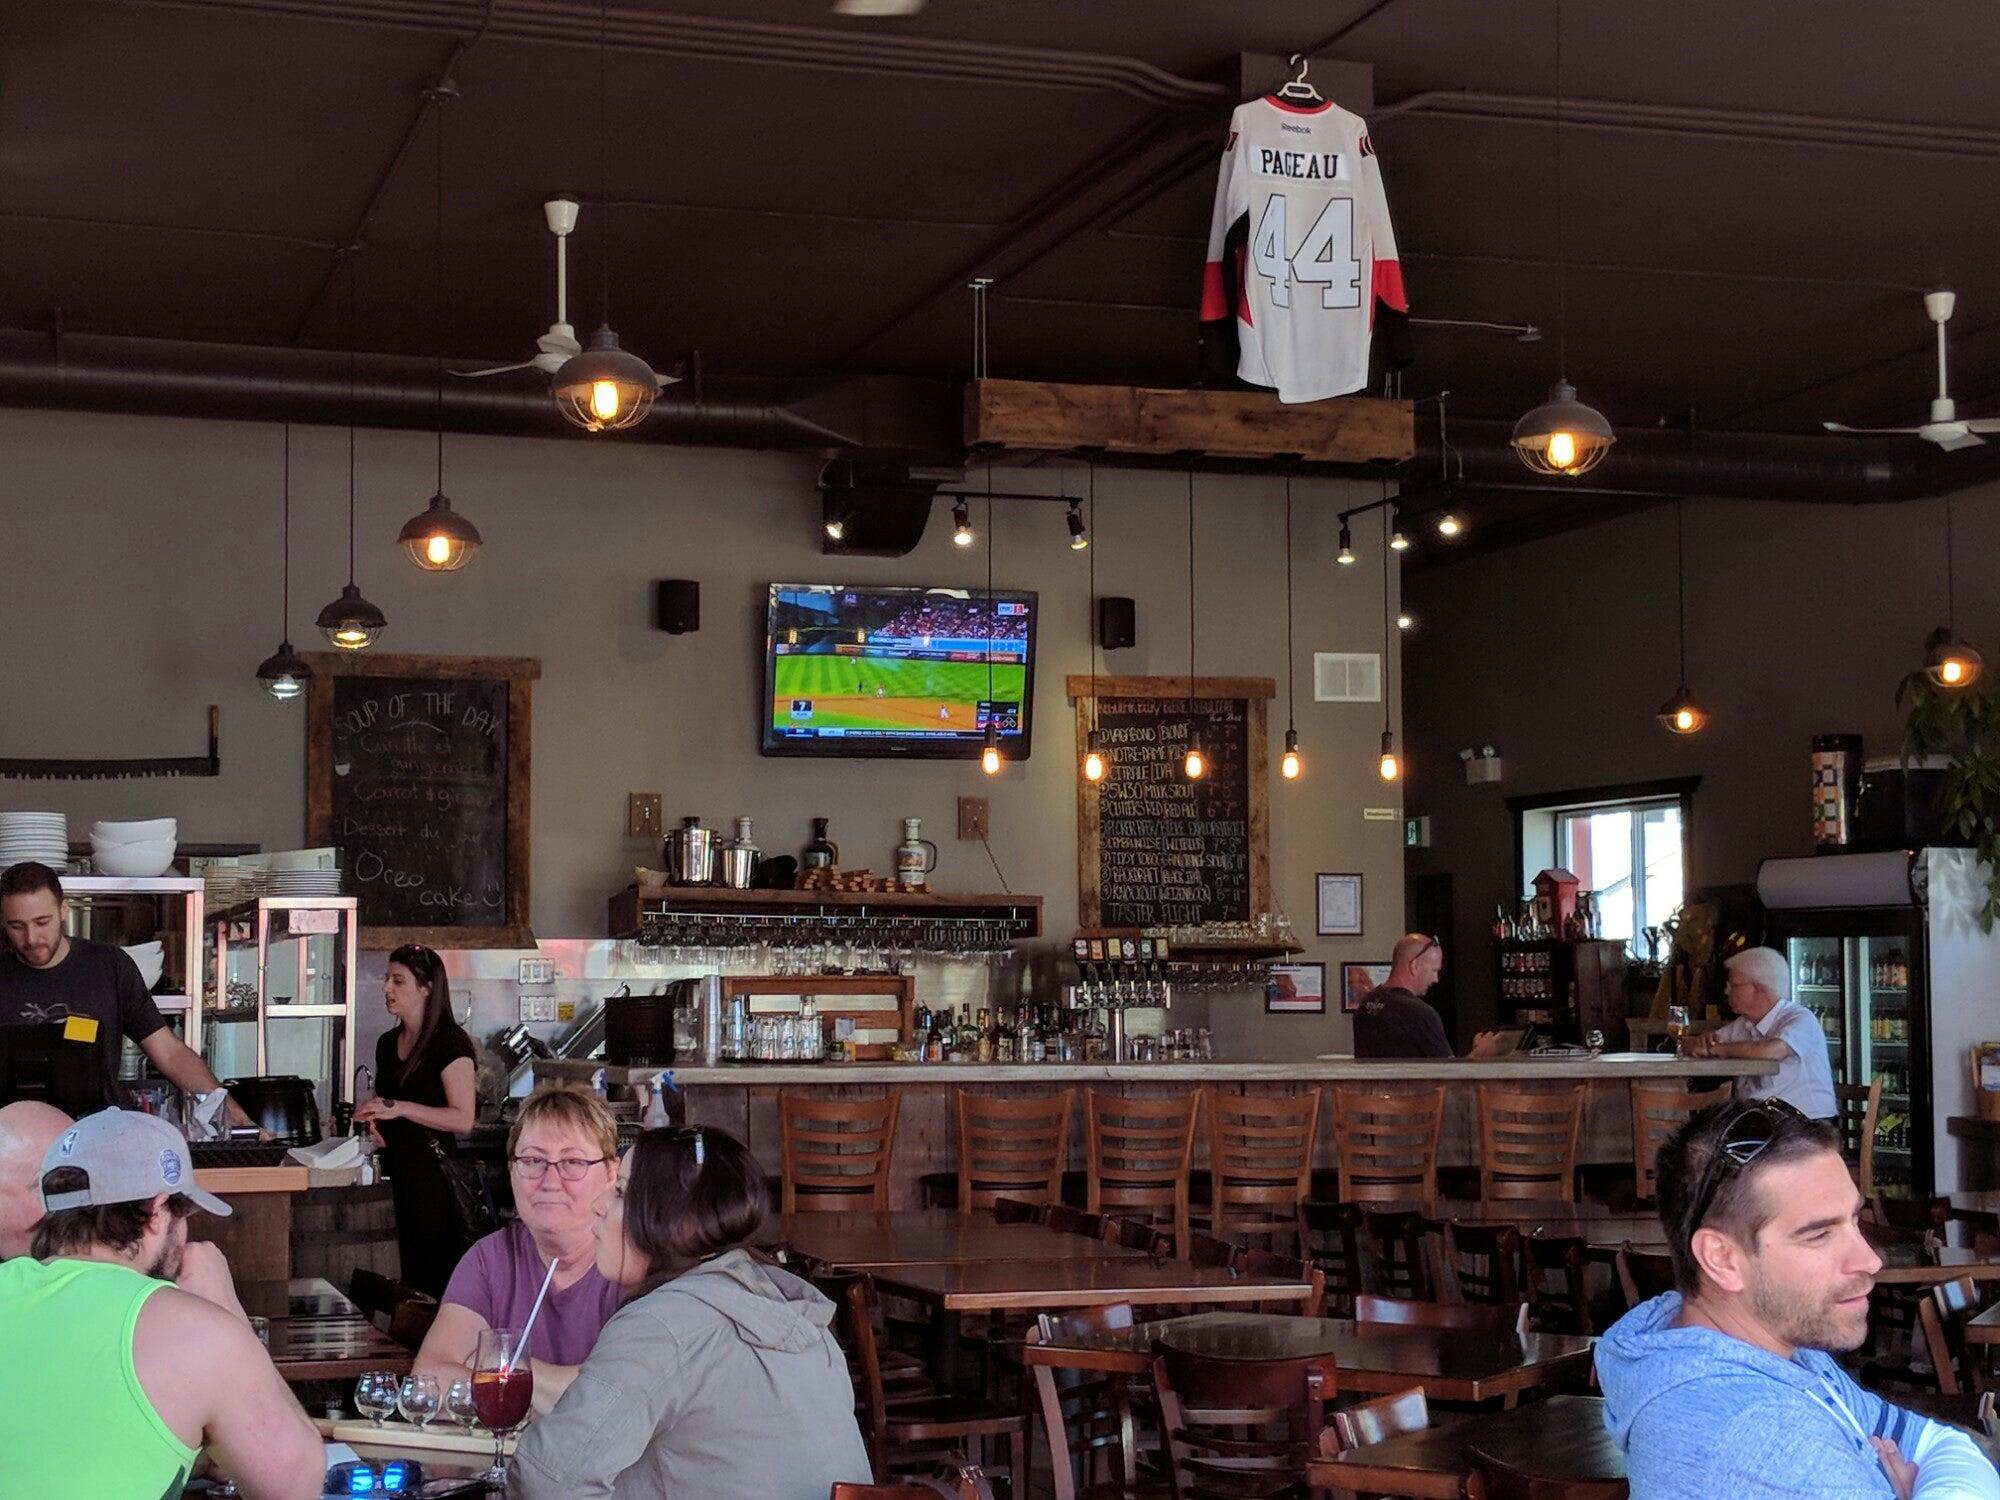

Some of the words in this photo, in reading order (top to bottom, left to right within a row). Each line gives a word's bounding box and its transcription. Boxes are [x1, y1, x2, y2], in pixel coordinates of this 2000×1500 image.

[1281, 123, 1312, 134] Reebok
[1261, 149, 1339, 179] PAGEAU
[1253, 193, 1361, 309] 44
[389, 693, 414, 719] OF
[422, 692, 455, 715] THE
[462, 706, 502, 736] DAY
[344, 817, 407, 837] Dessert
[355, 851, 424, 887] Oreo
[419, 886, 478, 907] cake
[1107, 902, 1155, 922] TASTER
[1161, 904, 1202, 924] FLIGHT
